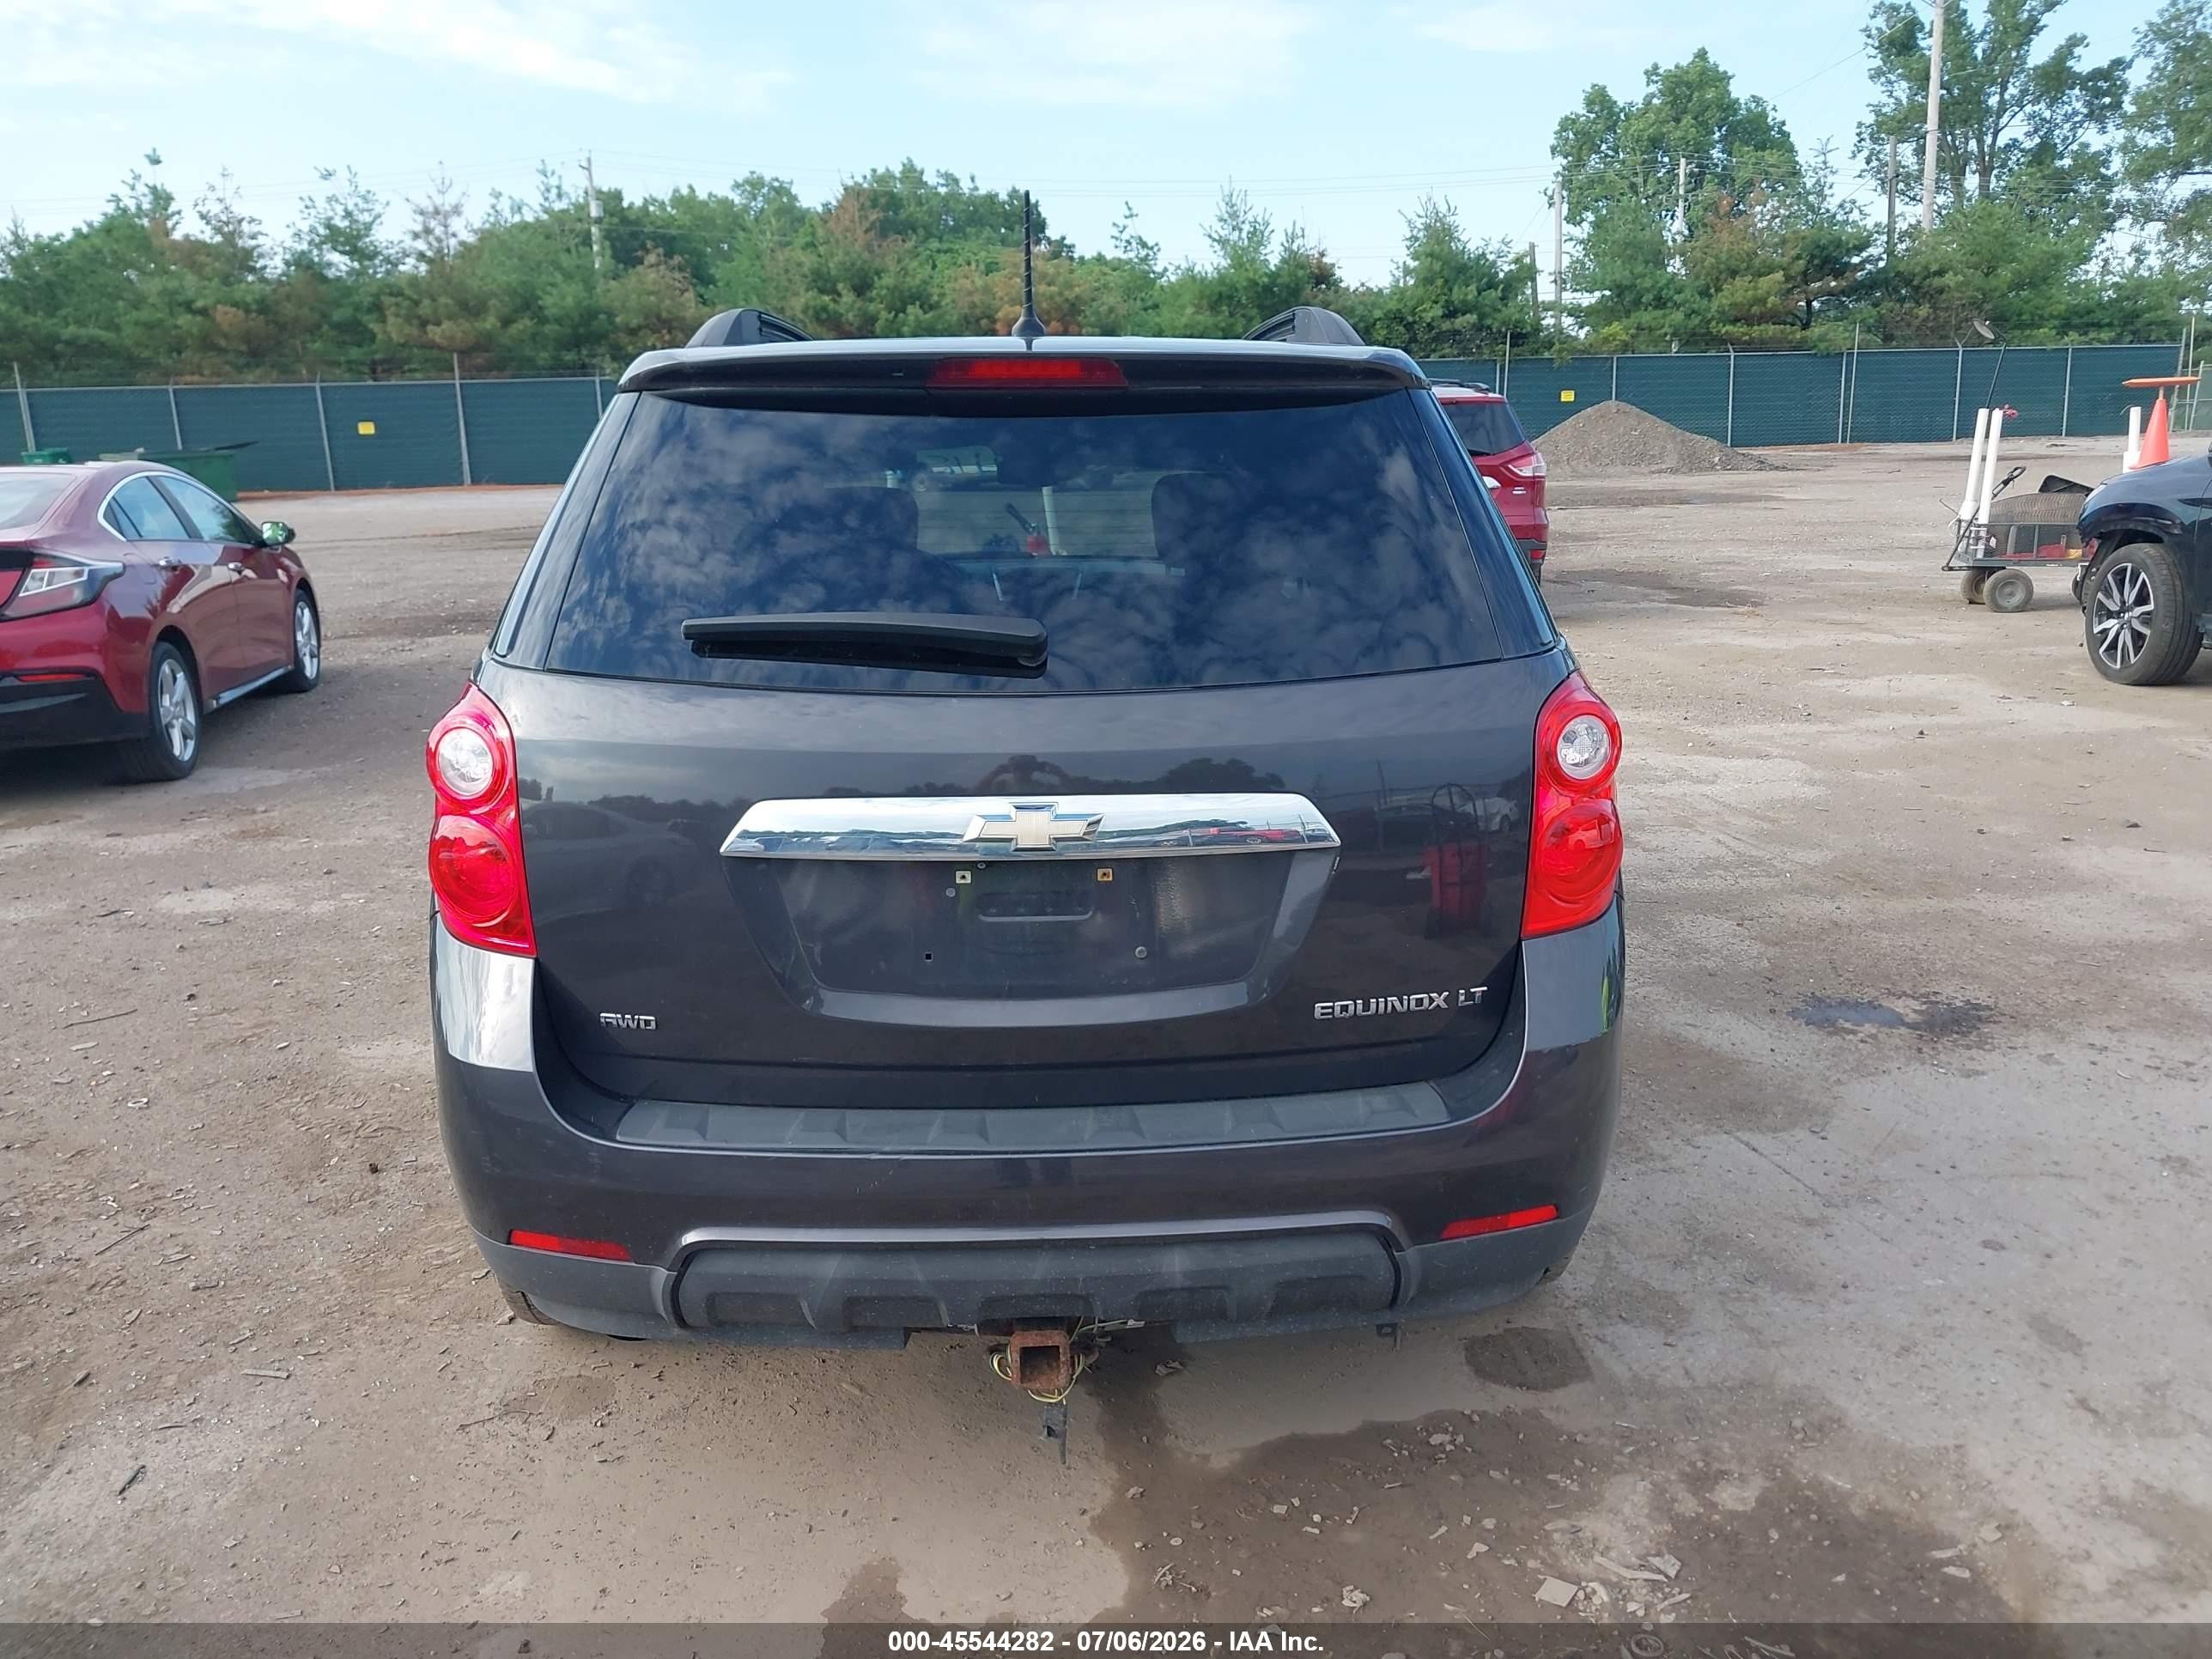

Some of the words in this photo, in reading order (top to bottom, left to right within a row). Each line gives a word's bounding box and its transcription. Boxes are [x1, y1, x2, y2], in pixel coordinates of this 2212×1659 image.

[1314, 991, 1449, 1020] EQUINOX
[1457, 986, 1488, 1006] LT
[599, 1012, 657, 1030] AWD
